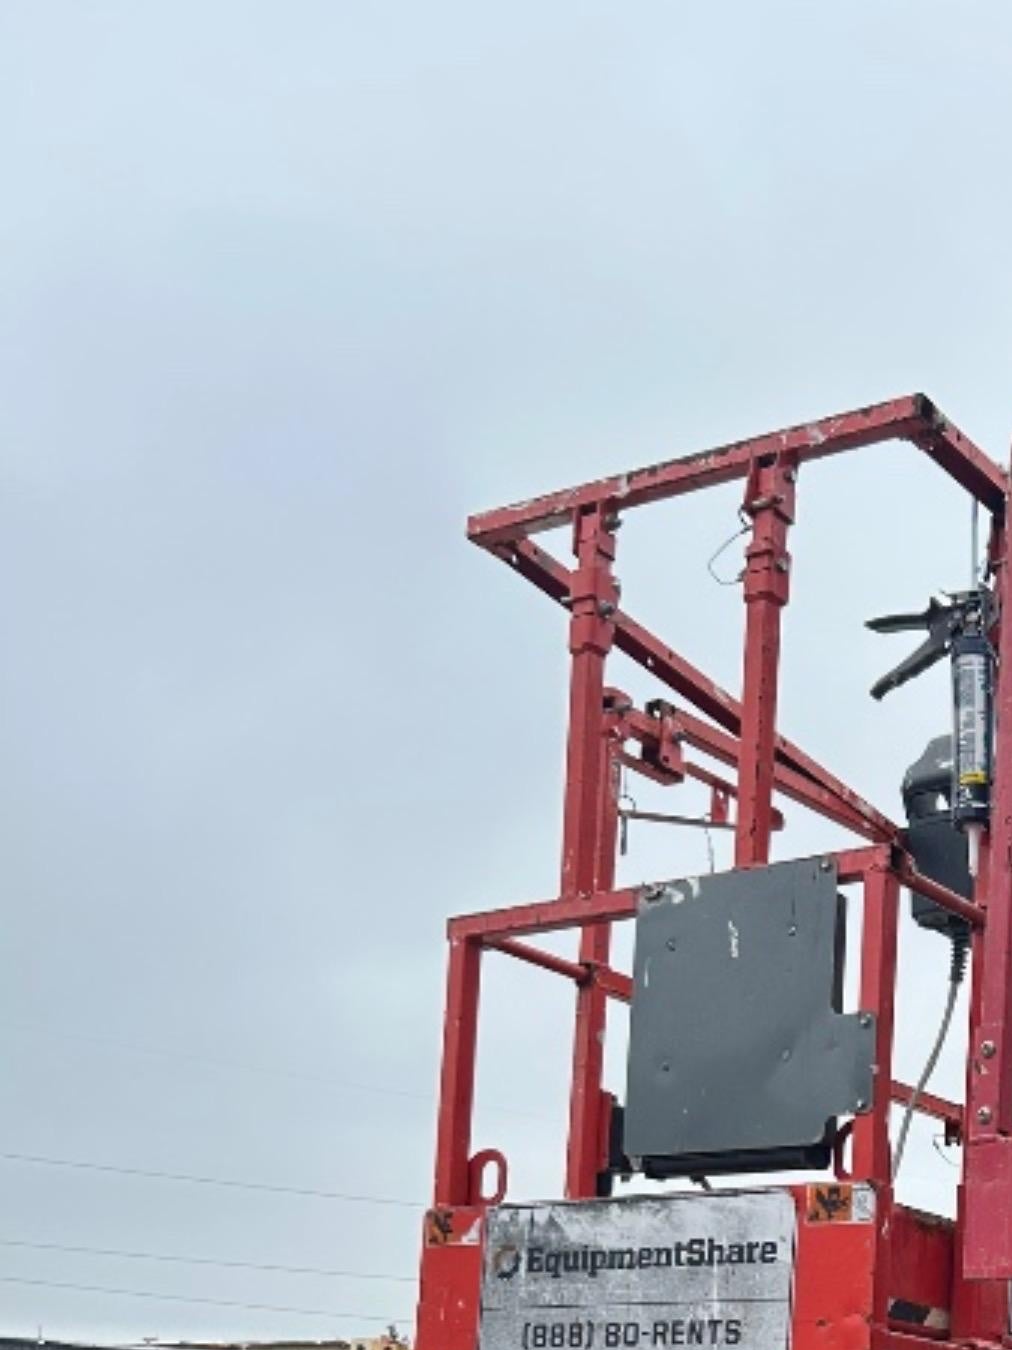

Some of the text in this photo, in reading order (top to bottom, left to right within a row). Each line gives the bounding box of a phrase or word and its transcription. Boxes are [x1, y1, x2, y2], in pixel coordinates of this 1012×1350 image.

[526, 1237, 778, 1279] EquipmentShare
[521, 1317, 743, 1350] (888) 80-RENTS
